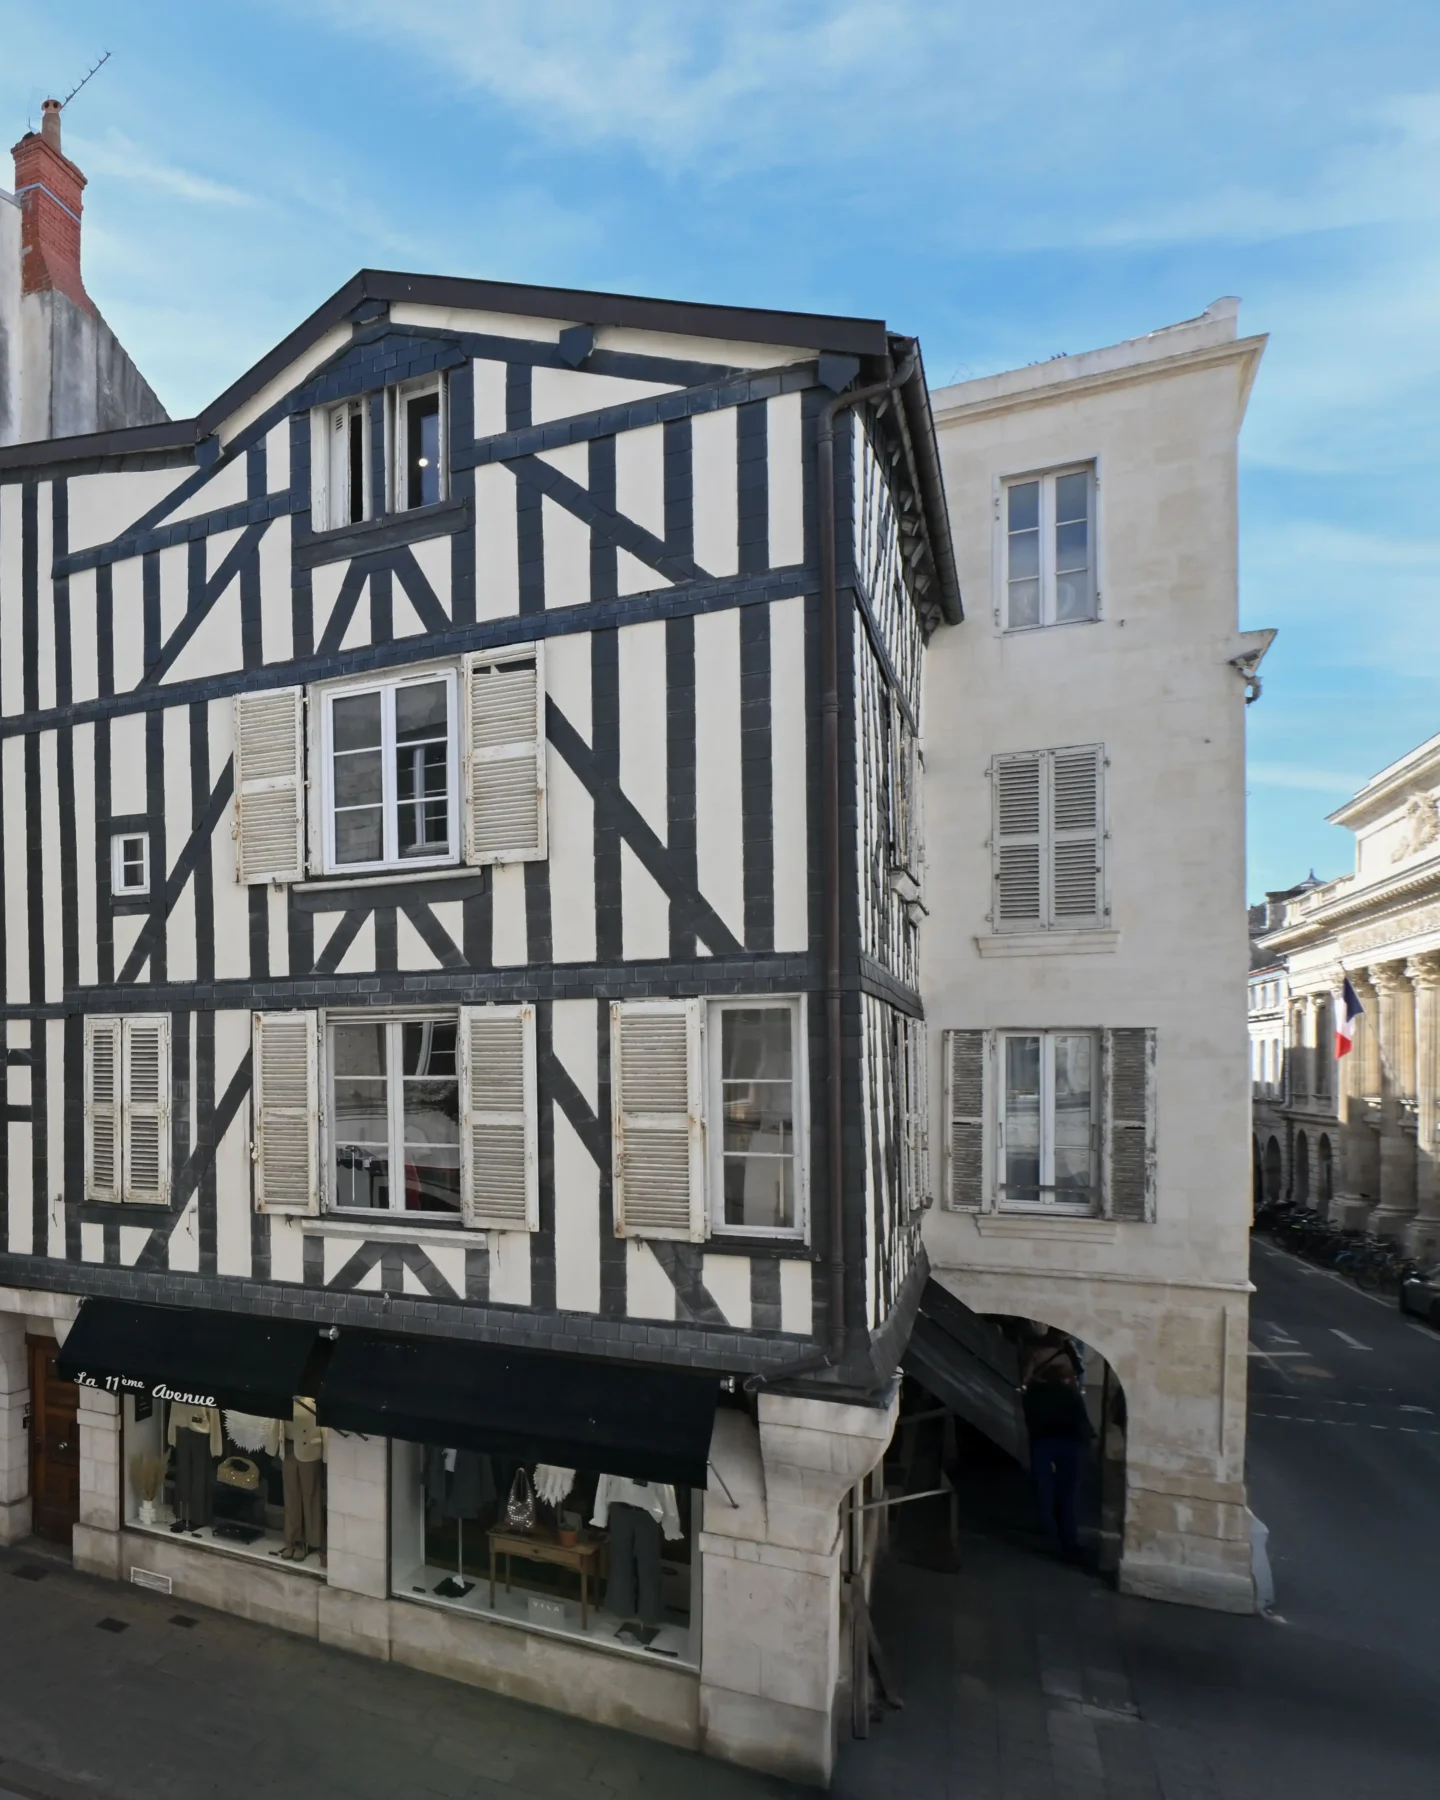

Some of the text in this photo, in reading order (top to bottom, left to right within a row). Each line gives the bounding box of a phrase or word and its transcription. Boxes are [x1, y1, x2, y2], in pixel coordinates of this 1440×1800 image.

[73, 1371, 98, 1388] La
[152, 1383, 217, 1407] Avenue
[532, 1601, 559, 1612] VILA
